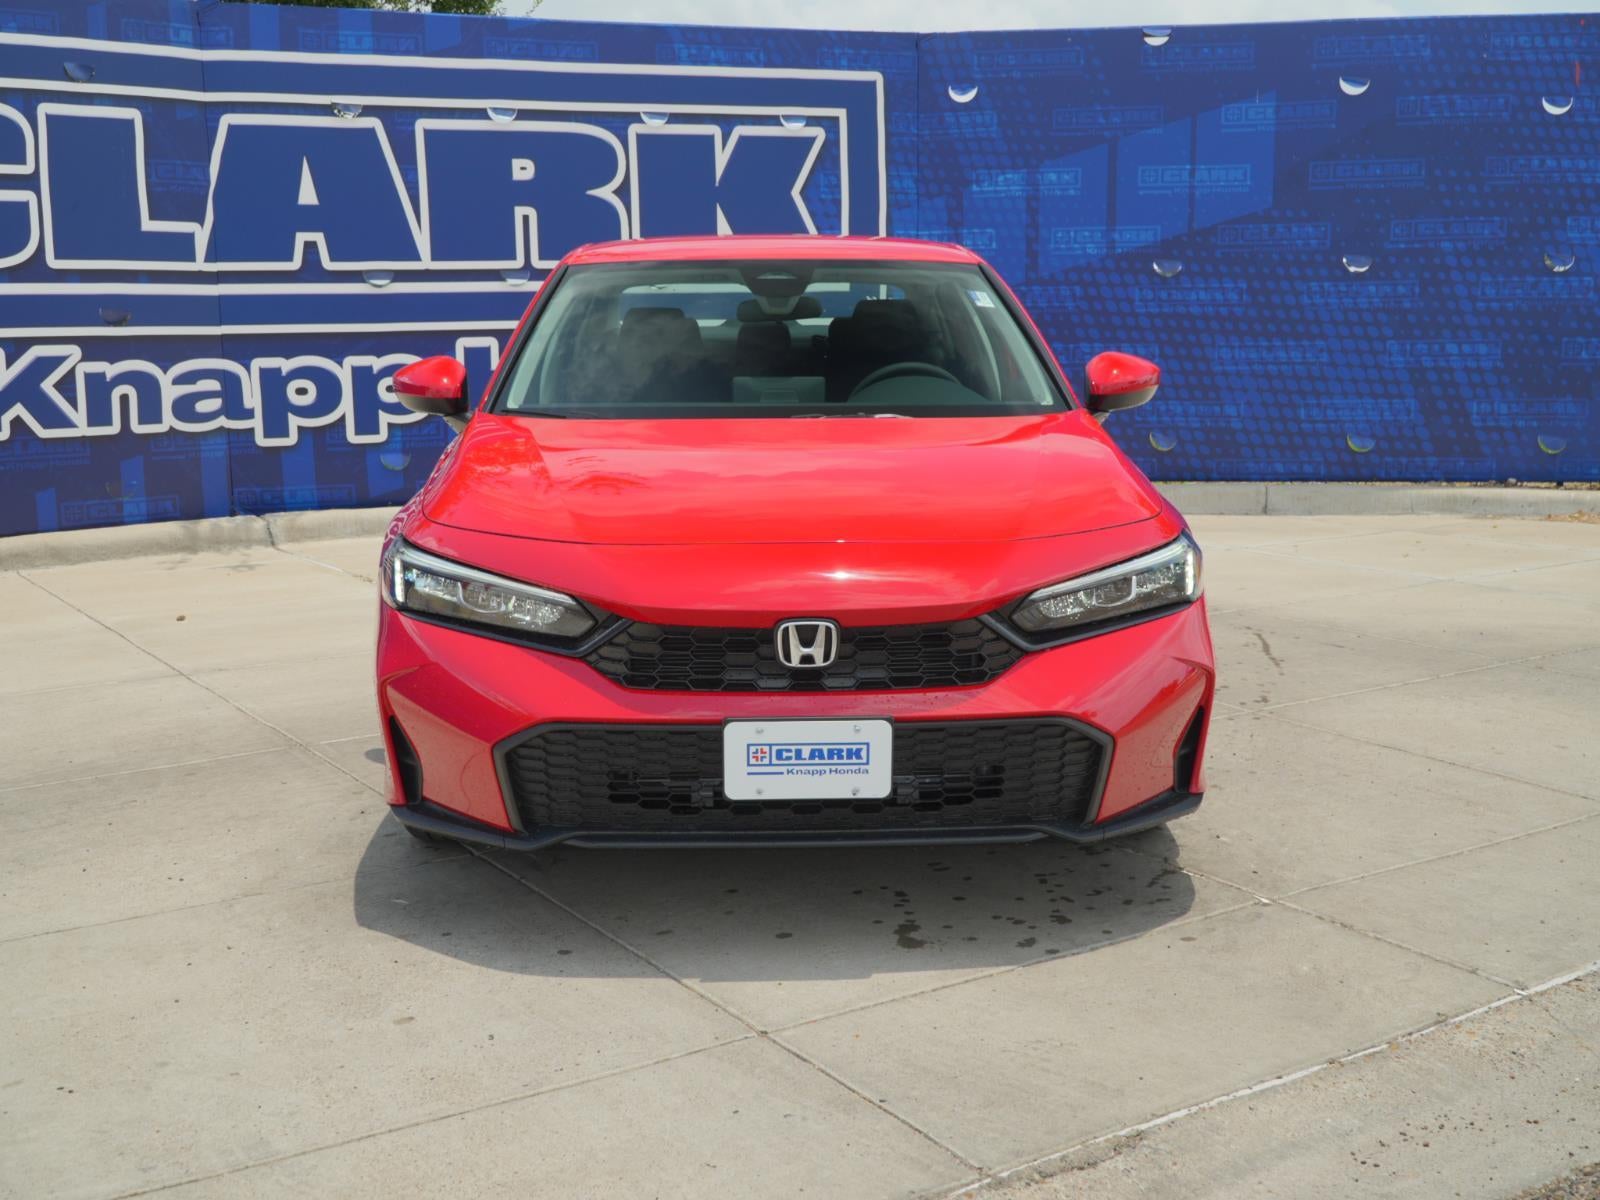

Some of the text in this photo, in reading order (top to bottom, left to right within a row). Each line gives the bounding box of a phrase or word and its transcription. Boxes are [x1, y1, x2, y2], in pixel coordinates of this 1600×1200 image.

[1163, 168, 1247, 182] CLARK
[0, 103, 825, 272] LARK
[0, 344, 432, 447] Knapp
[775, 747, 864, 761] CLARK
[786, 767, 869, 776] Knapp Honda
